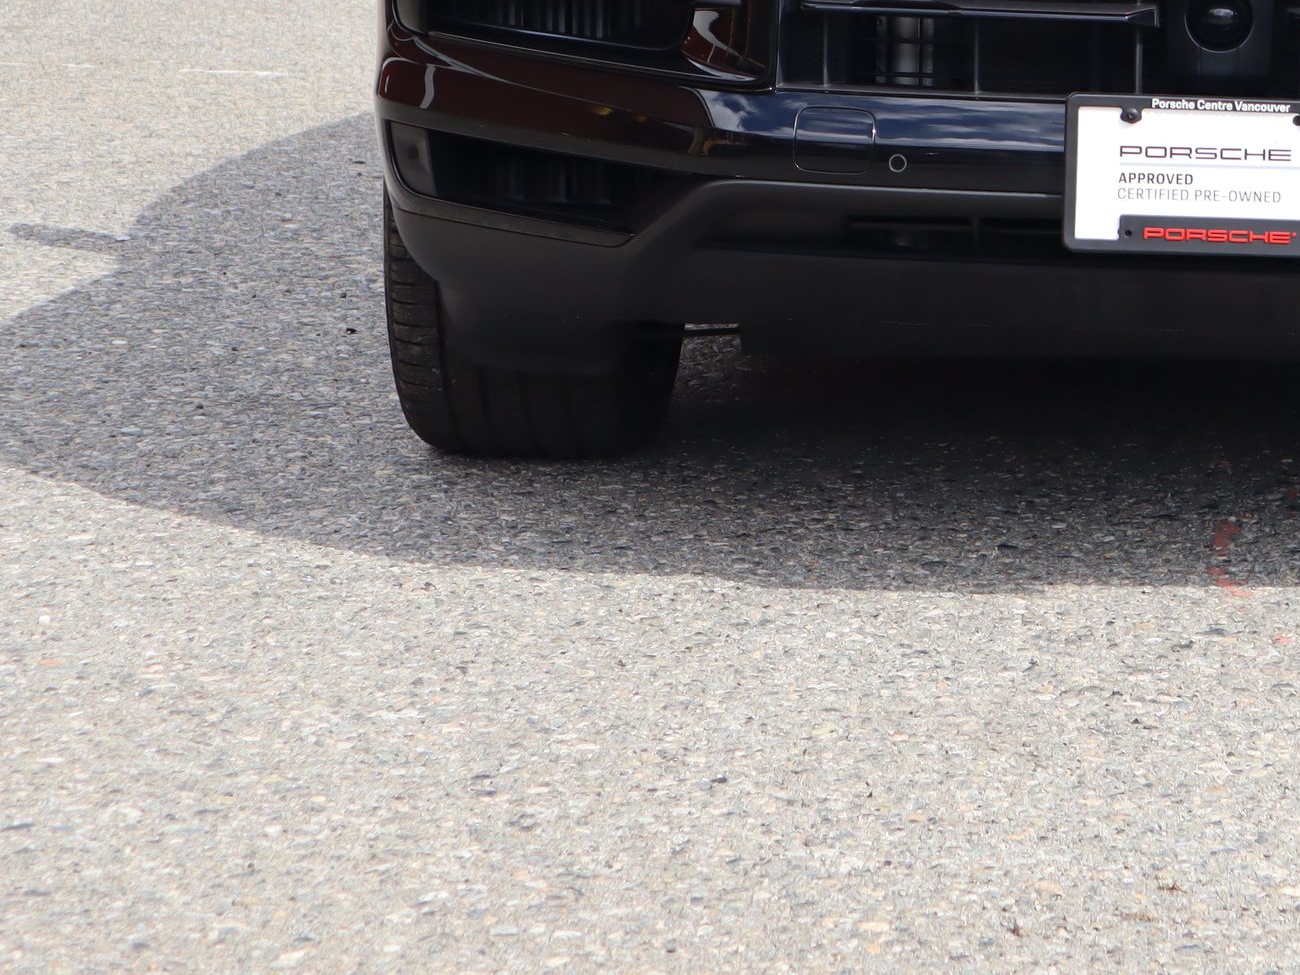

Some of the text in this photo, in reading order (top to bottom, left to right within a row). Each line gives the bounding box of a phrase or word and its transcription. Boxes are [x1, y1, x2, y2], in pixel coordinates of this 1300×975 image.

[1151, 98, 1291, 113] Porsche Centre Vancouver
[1119, 145, 1292, 162] PORSCHE
[1118, 172, 1194, 185] APPROVED
[1117, 187, 1281, 203] CERTIFIED PRE-OWNED
[1143, 227, 1293, 245] PORSCHE
